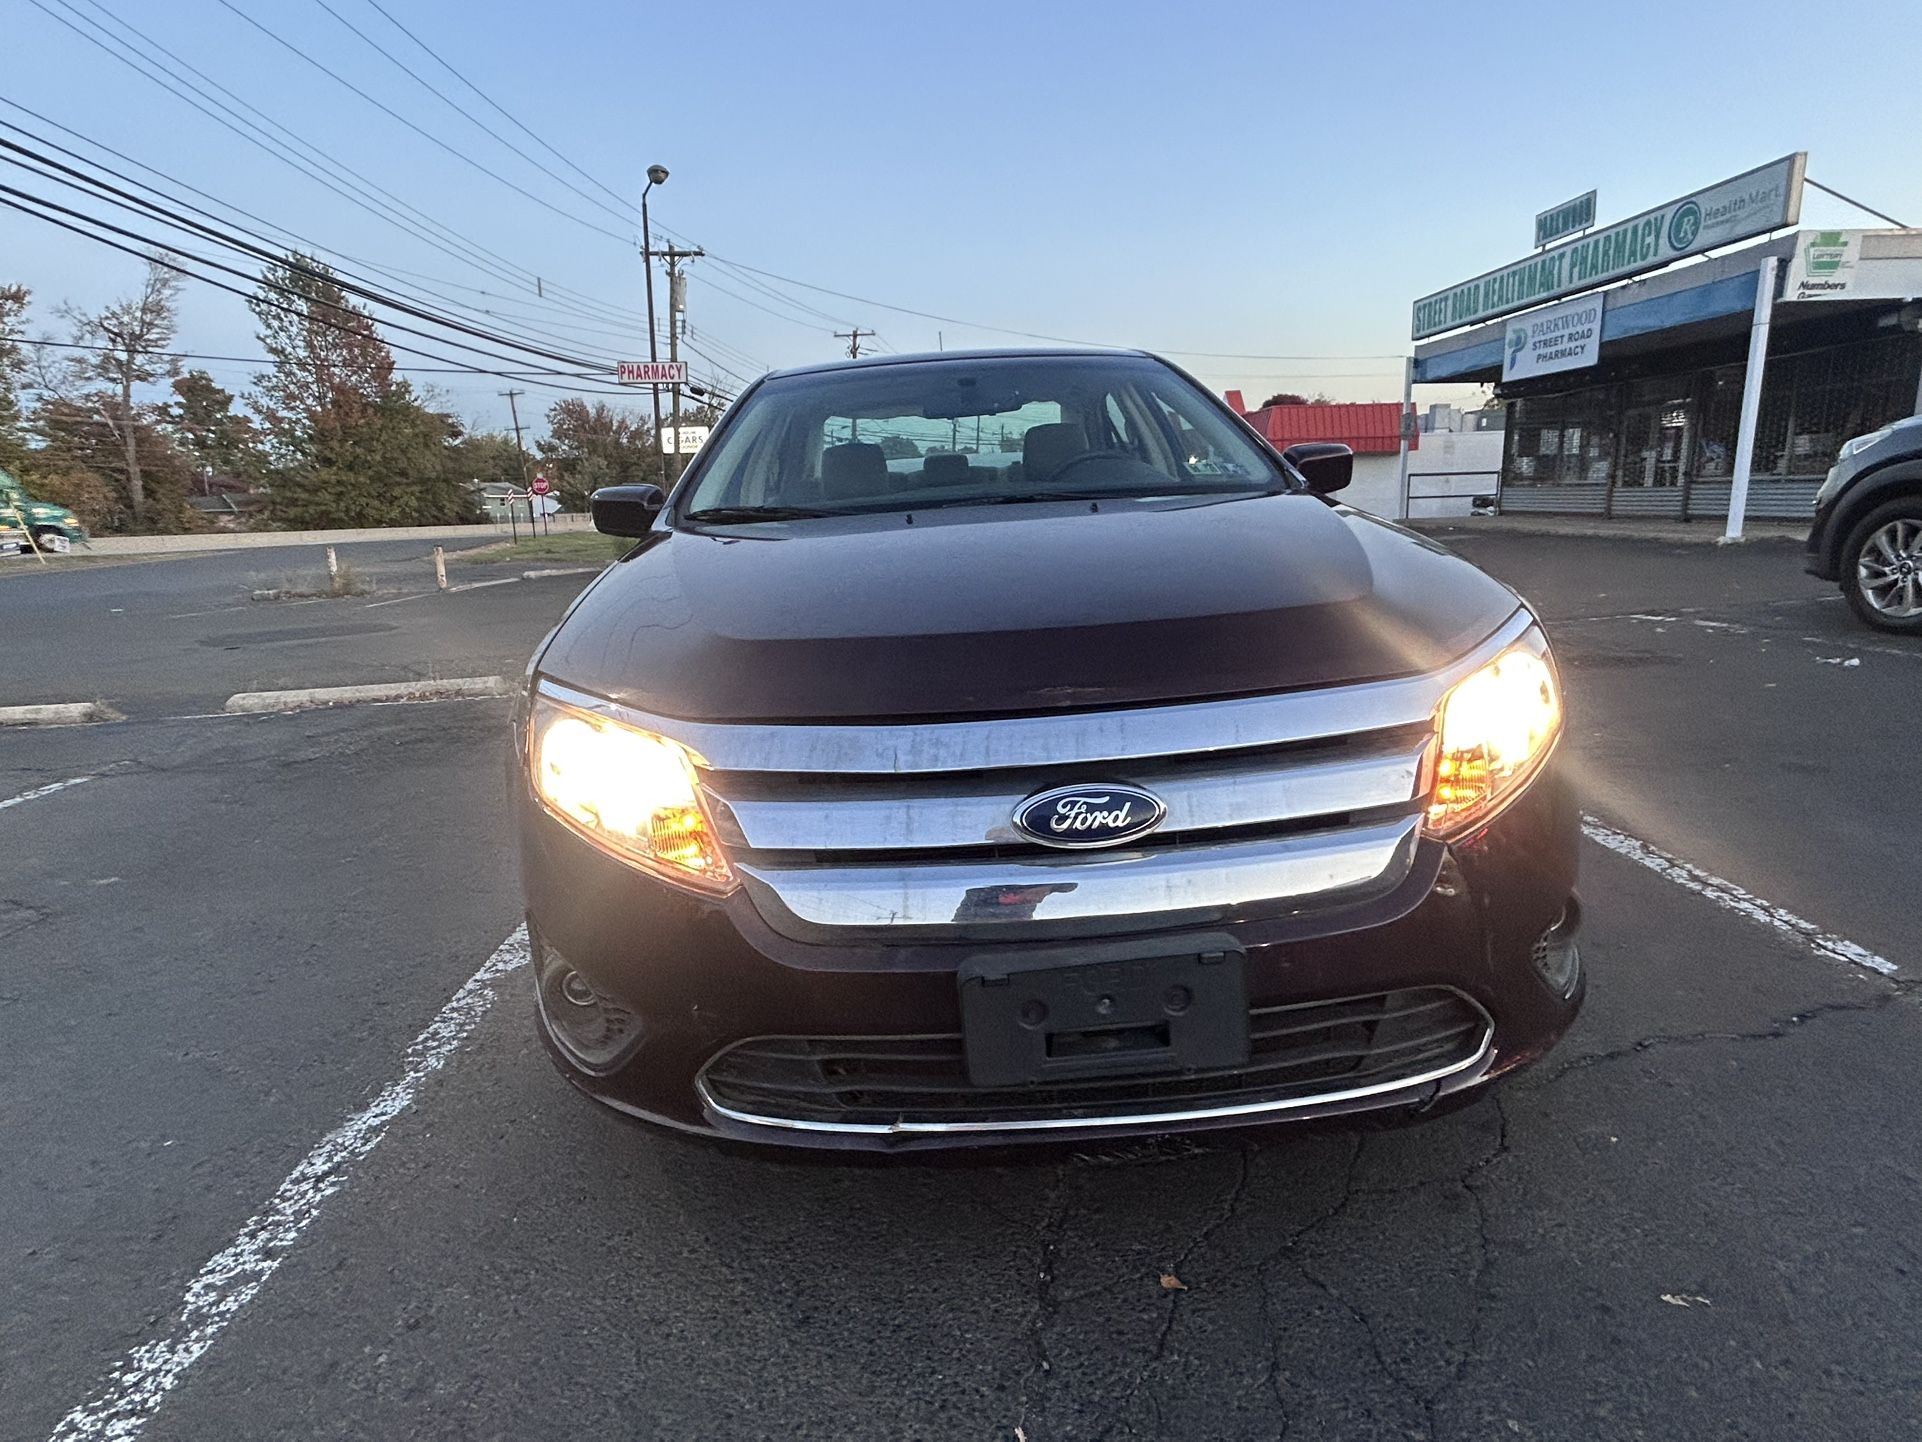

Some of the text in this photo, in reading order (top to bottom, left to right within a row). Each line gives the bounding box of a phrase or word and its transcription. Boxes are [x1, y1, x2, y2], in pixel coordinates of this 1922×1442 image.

[1704, 196, 1746, 222] Health
[1749, 184, 1781, 204] Mart
[1415, 294, 1449, 334] STREET
[1451, 283, 1480, 322] ROAD
[1482, 229, 1566, 313] HEALTHMART
[1569, 213, 1665, 284] PHARMACY
[1797, 280, 1846, 291] Numbers
[1531, 308, 1597, 339] PARKWOOD
[1532, 328, 1593, 351] STREET ROAD
[1536, 344, 1586, 364] PHARMACY
[620, 364, 683, 381] PHARMACY
[533, 482, 548, 490] STOP
[1049, 795, 1132, 833] Ford
